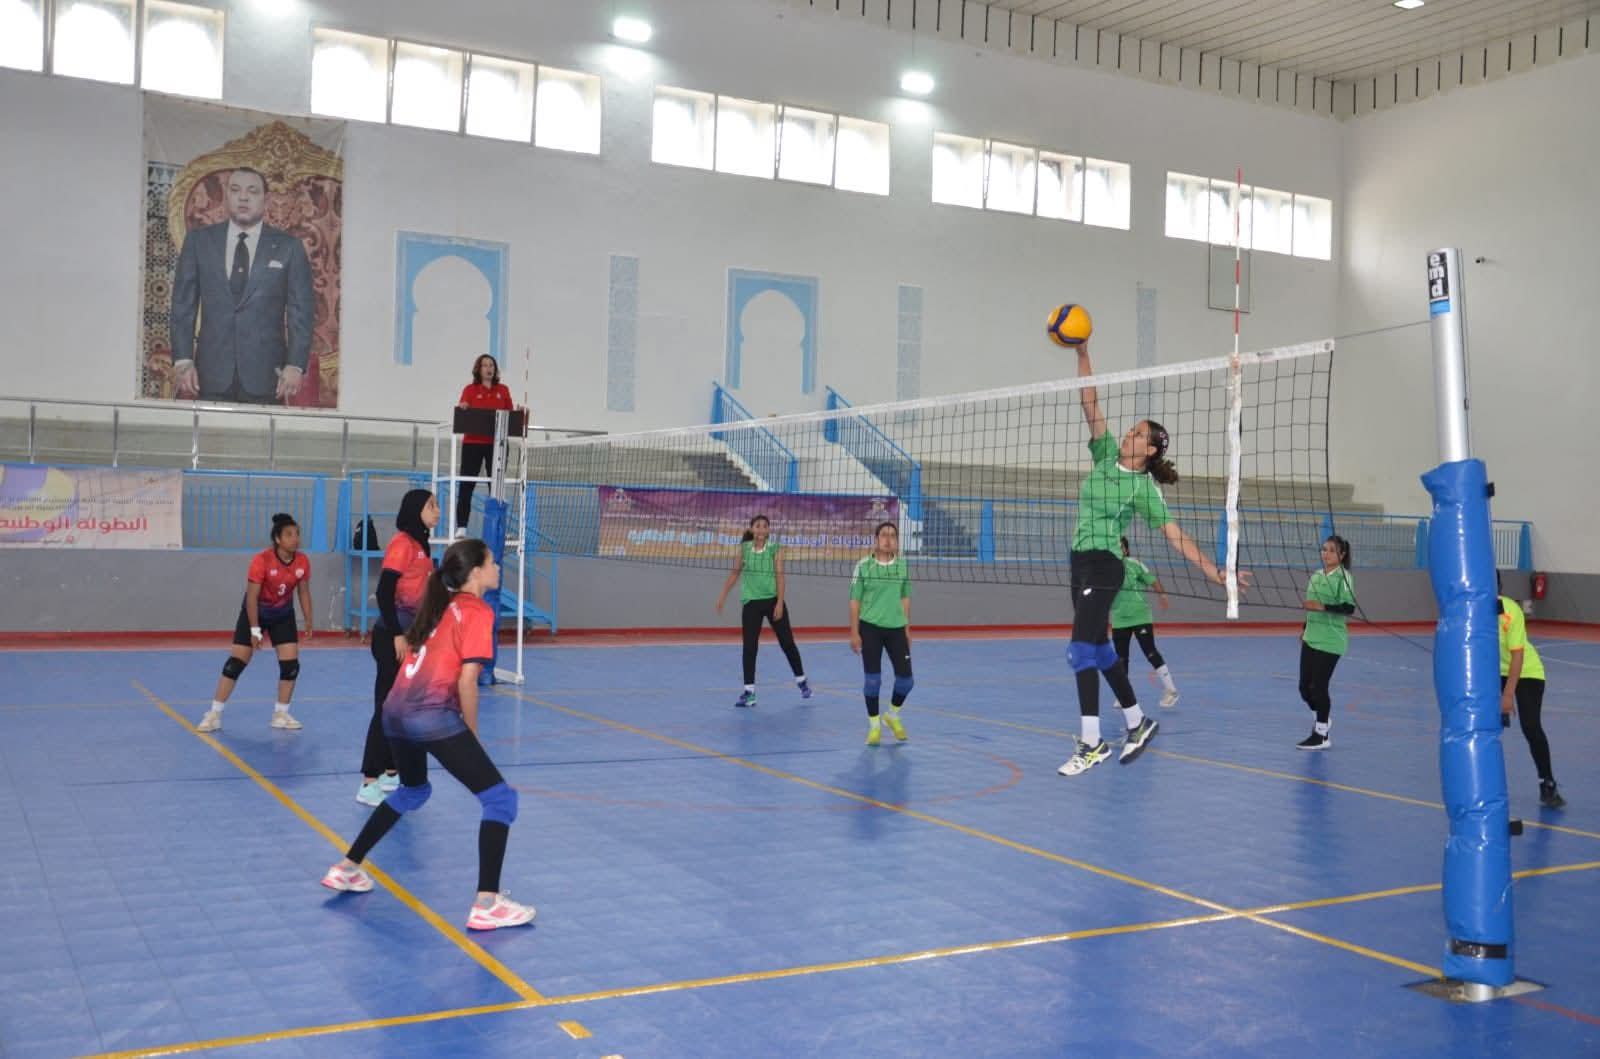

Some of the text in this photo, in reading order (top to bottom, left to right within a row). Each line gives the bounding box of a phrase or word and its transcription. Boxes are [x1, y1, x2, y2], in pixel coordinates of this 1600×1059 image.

[1429, 253, 1445, 297] emd
[76, 516, 148, 534] البطولة
[278, 583, 287, 596] 3
